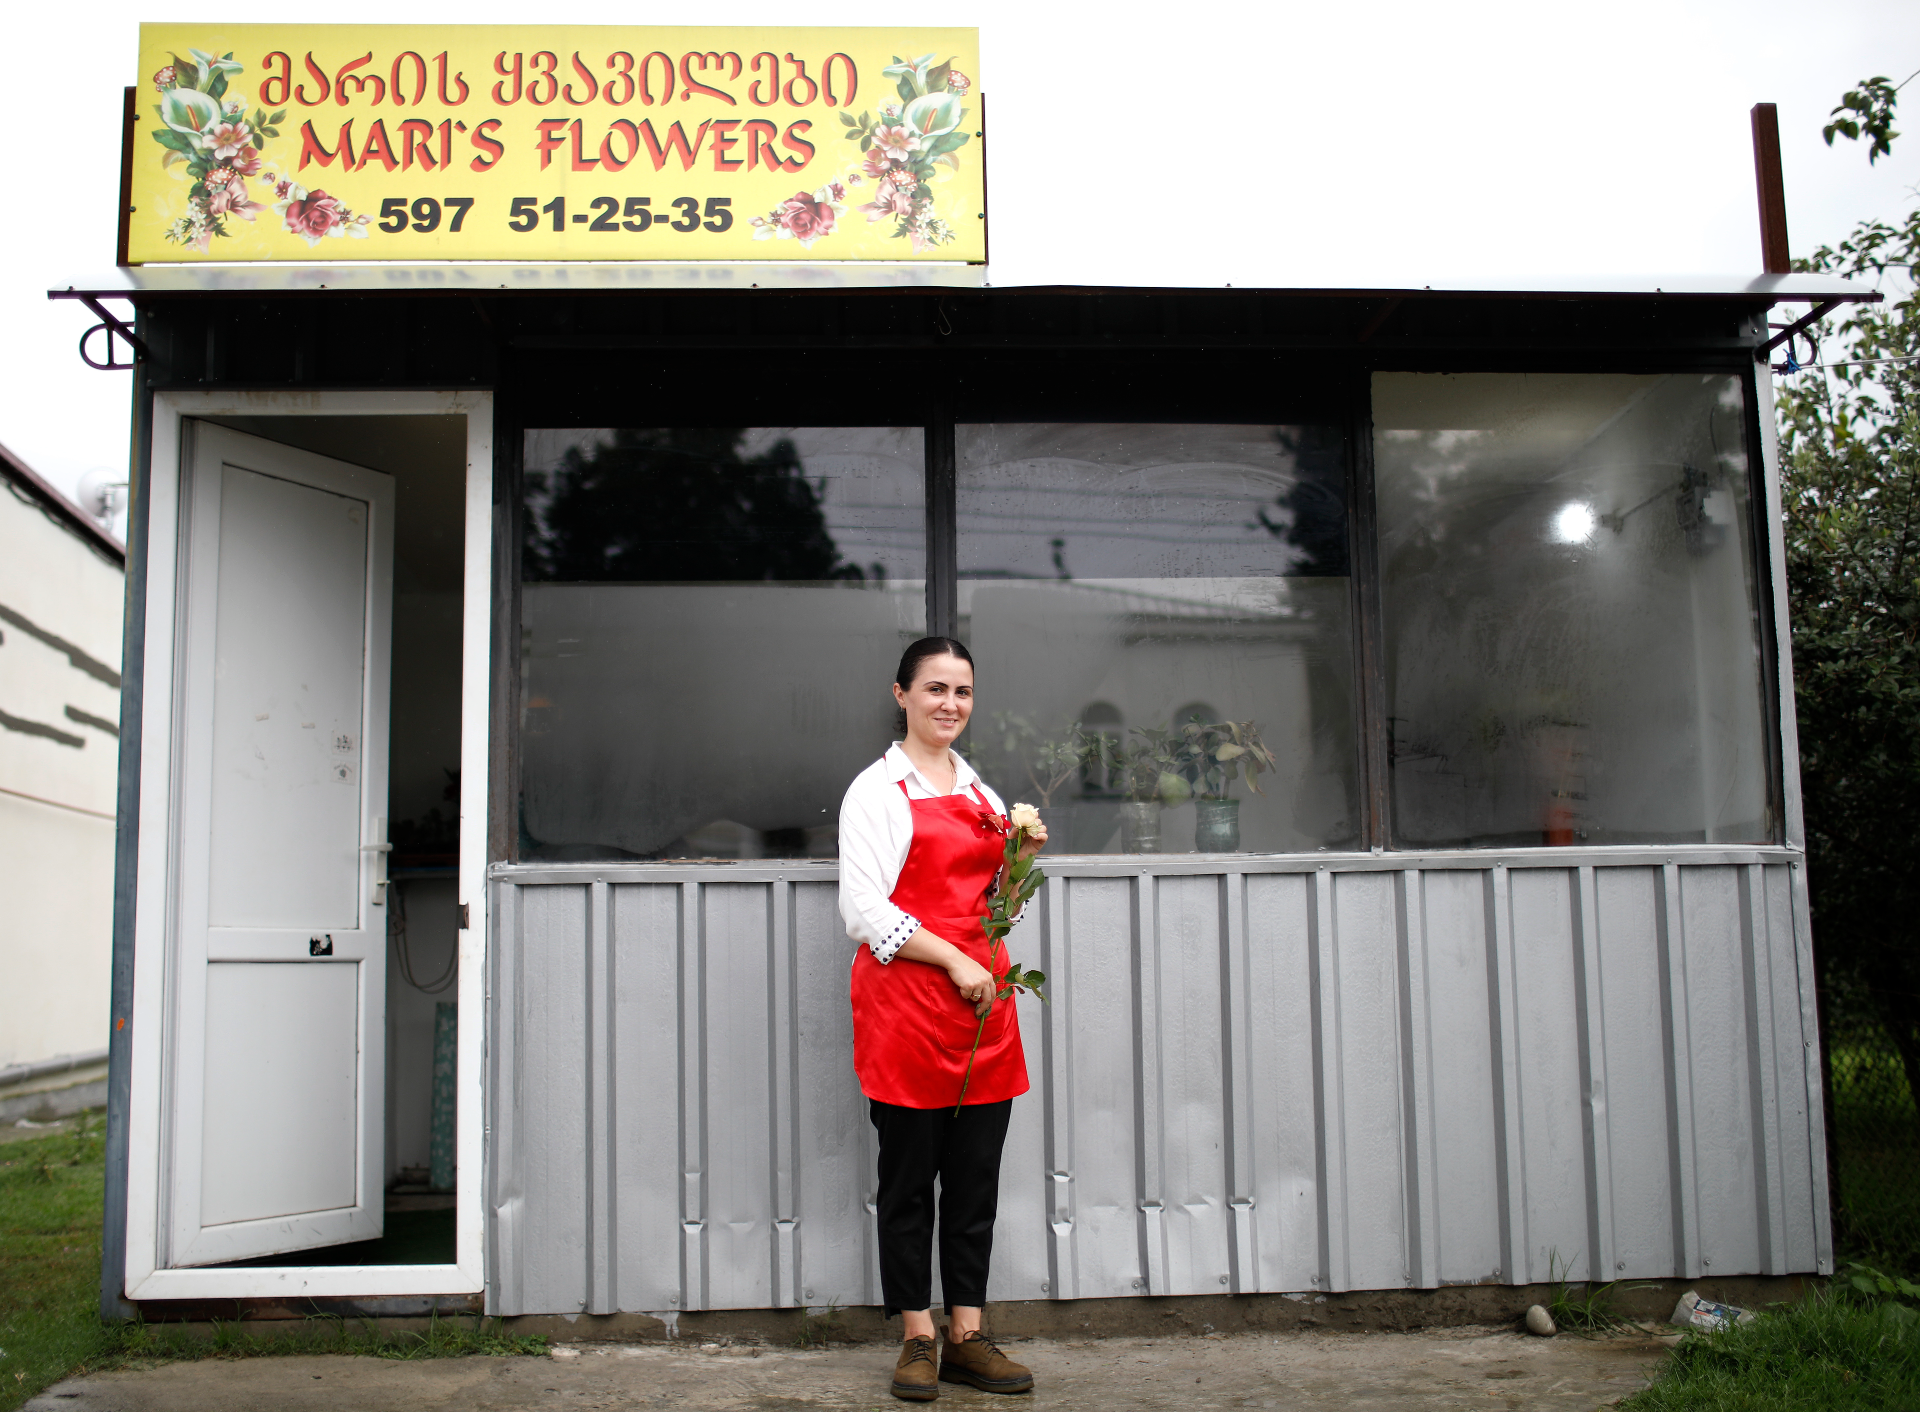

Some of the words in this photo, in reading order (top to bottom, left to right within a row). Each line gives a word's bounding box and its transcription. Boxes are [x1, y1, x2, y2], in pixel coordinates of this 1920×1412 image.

[260, 51, 470, 107] მარის
[492, 51, 858, 107] ყვავილები
[535, 117, 816, 173] FLOWERS
[378, 197, 475, 233] 597
[508, 196, 734, 233] 51-25-35
